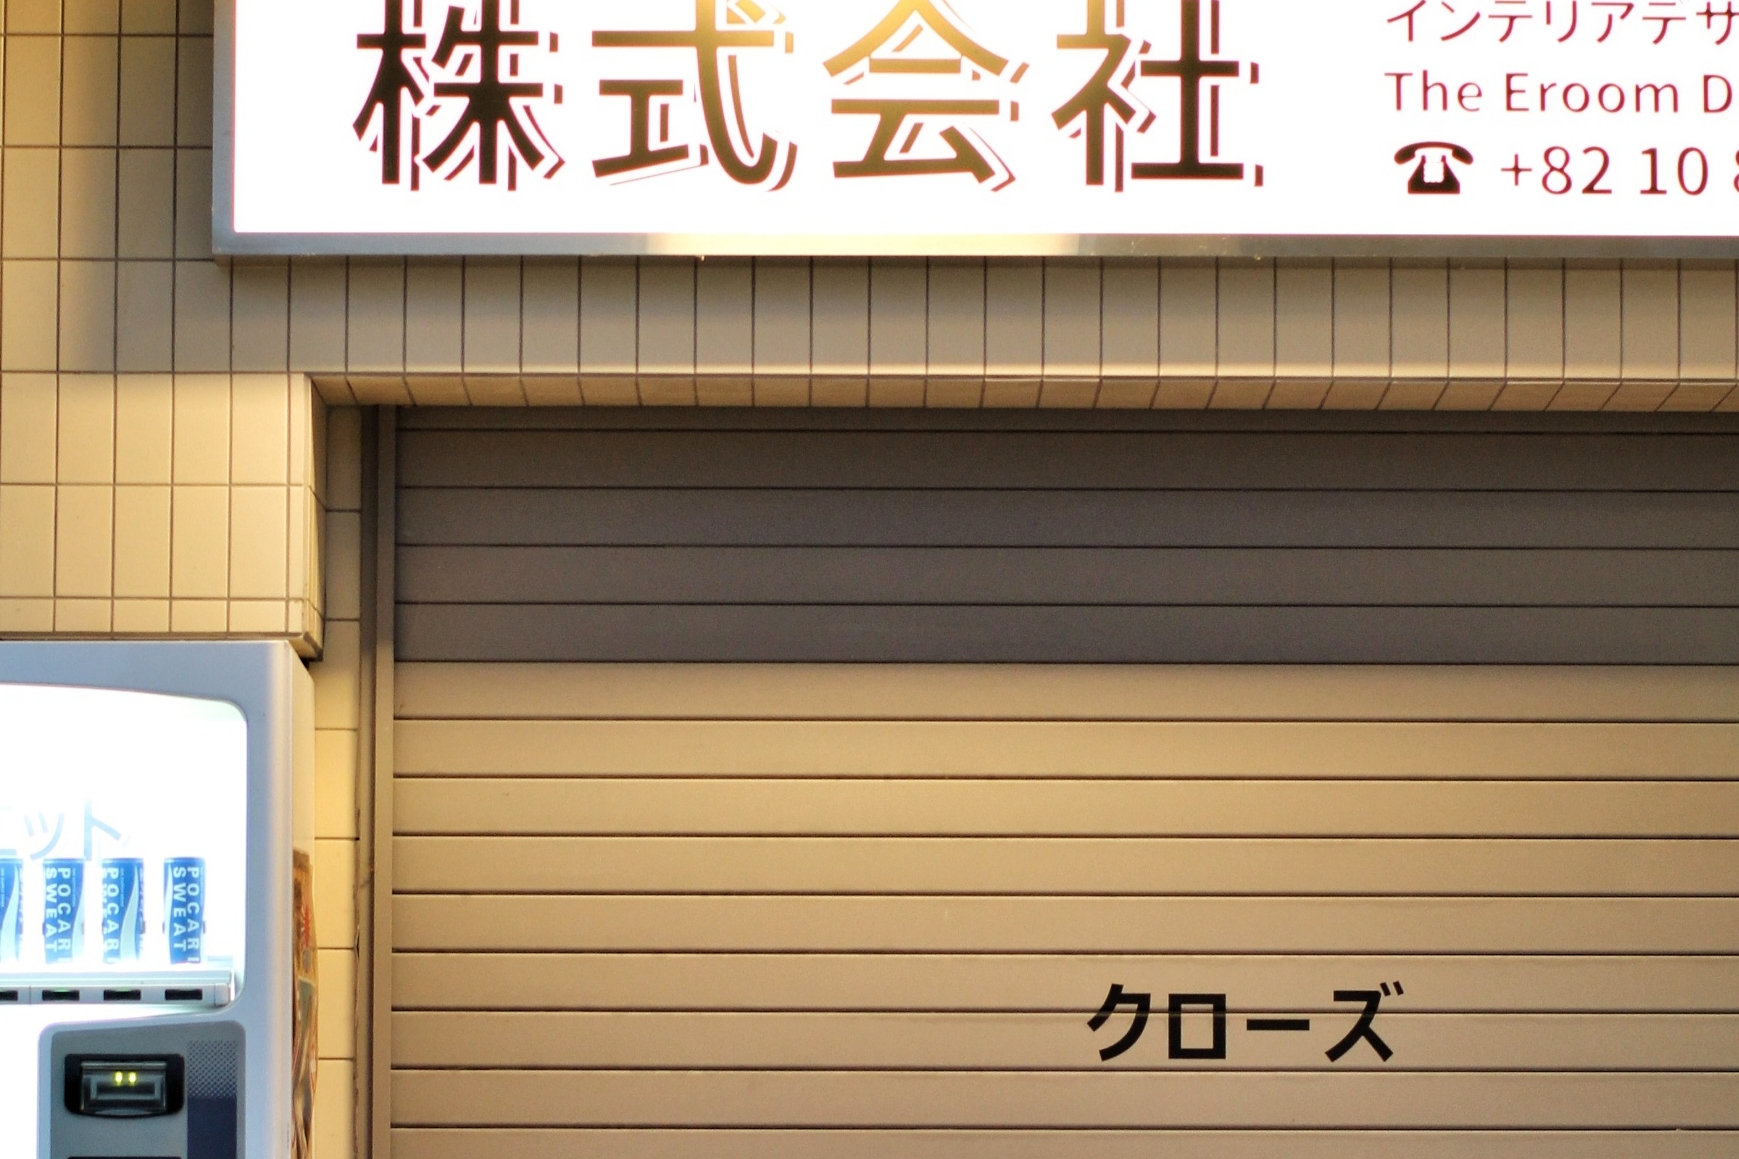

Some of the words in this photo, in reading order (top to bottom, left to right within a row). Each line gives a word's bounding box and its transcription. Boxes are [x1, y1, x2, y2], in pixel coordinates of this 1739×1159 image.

[352, 0, 1263, 192] 株式会社
[1384, 69, 1483, 112] The
[1505, 72, 1679, 113] Eroom
[1703, 74, 1733, 113] D
[1500, 146, 1613, 195] +82
[1640, 147, 1709, 196] 10
[45, 867, 58, 953] SWEAT
[57, 867, 72, 963] POCARI
[106, 867, 120, 963] POCARI
[173, 866, 187, 952] SWEAT
[187, 866, 200, 963] POCARI
[1087, 981, 1404, 1062] クローズ
